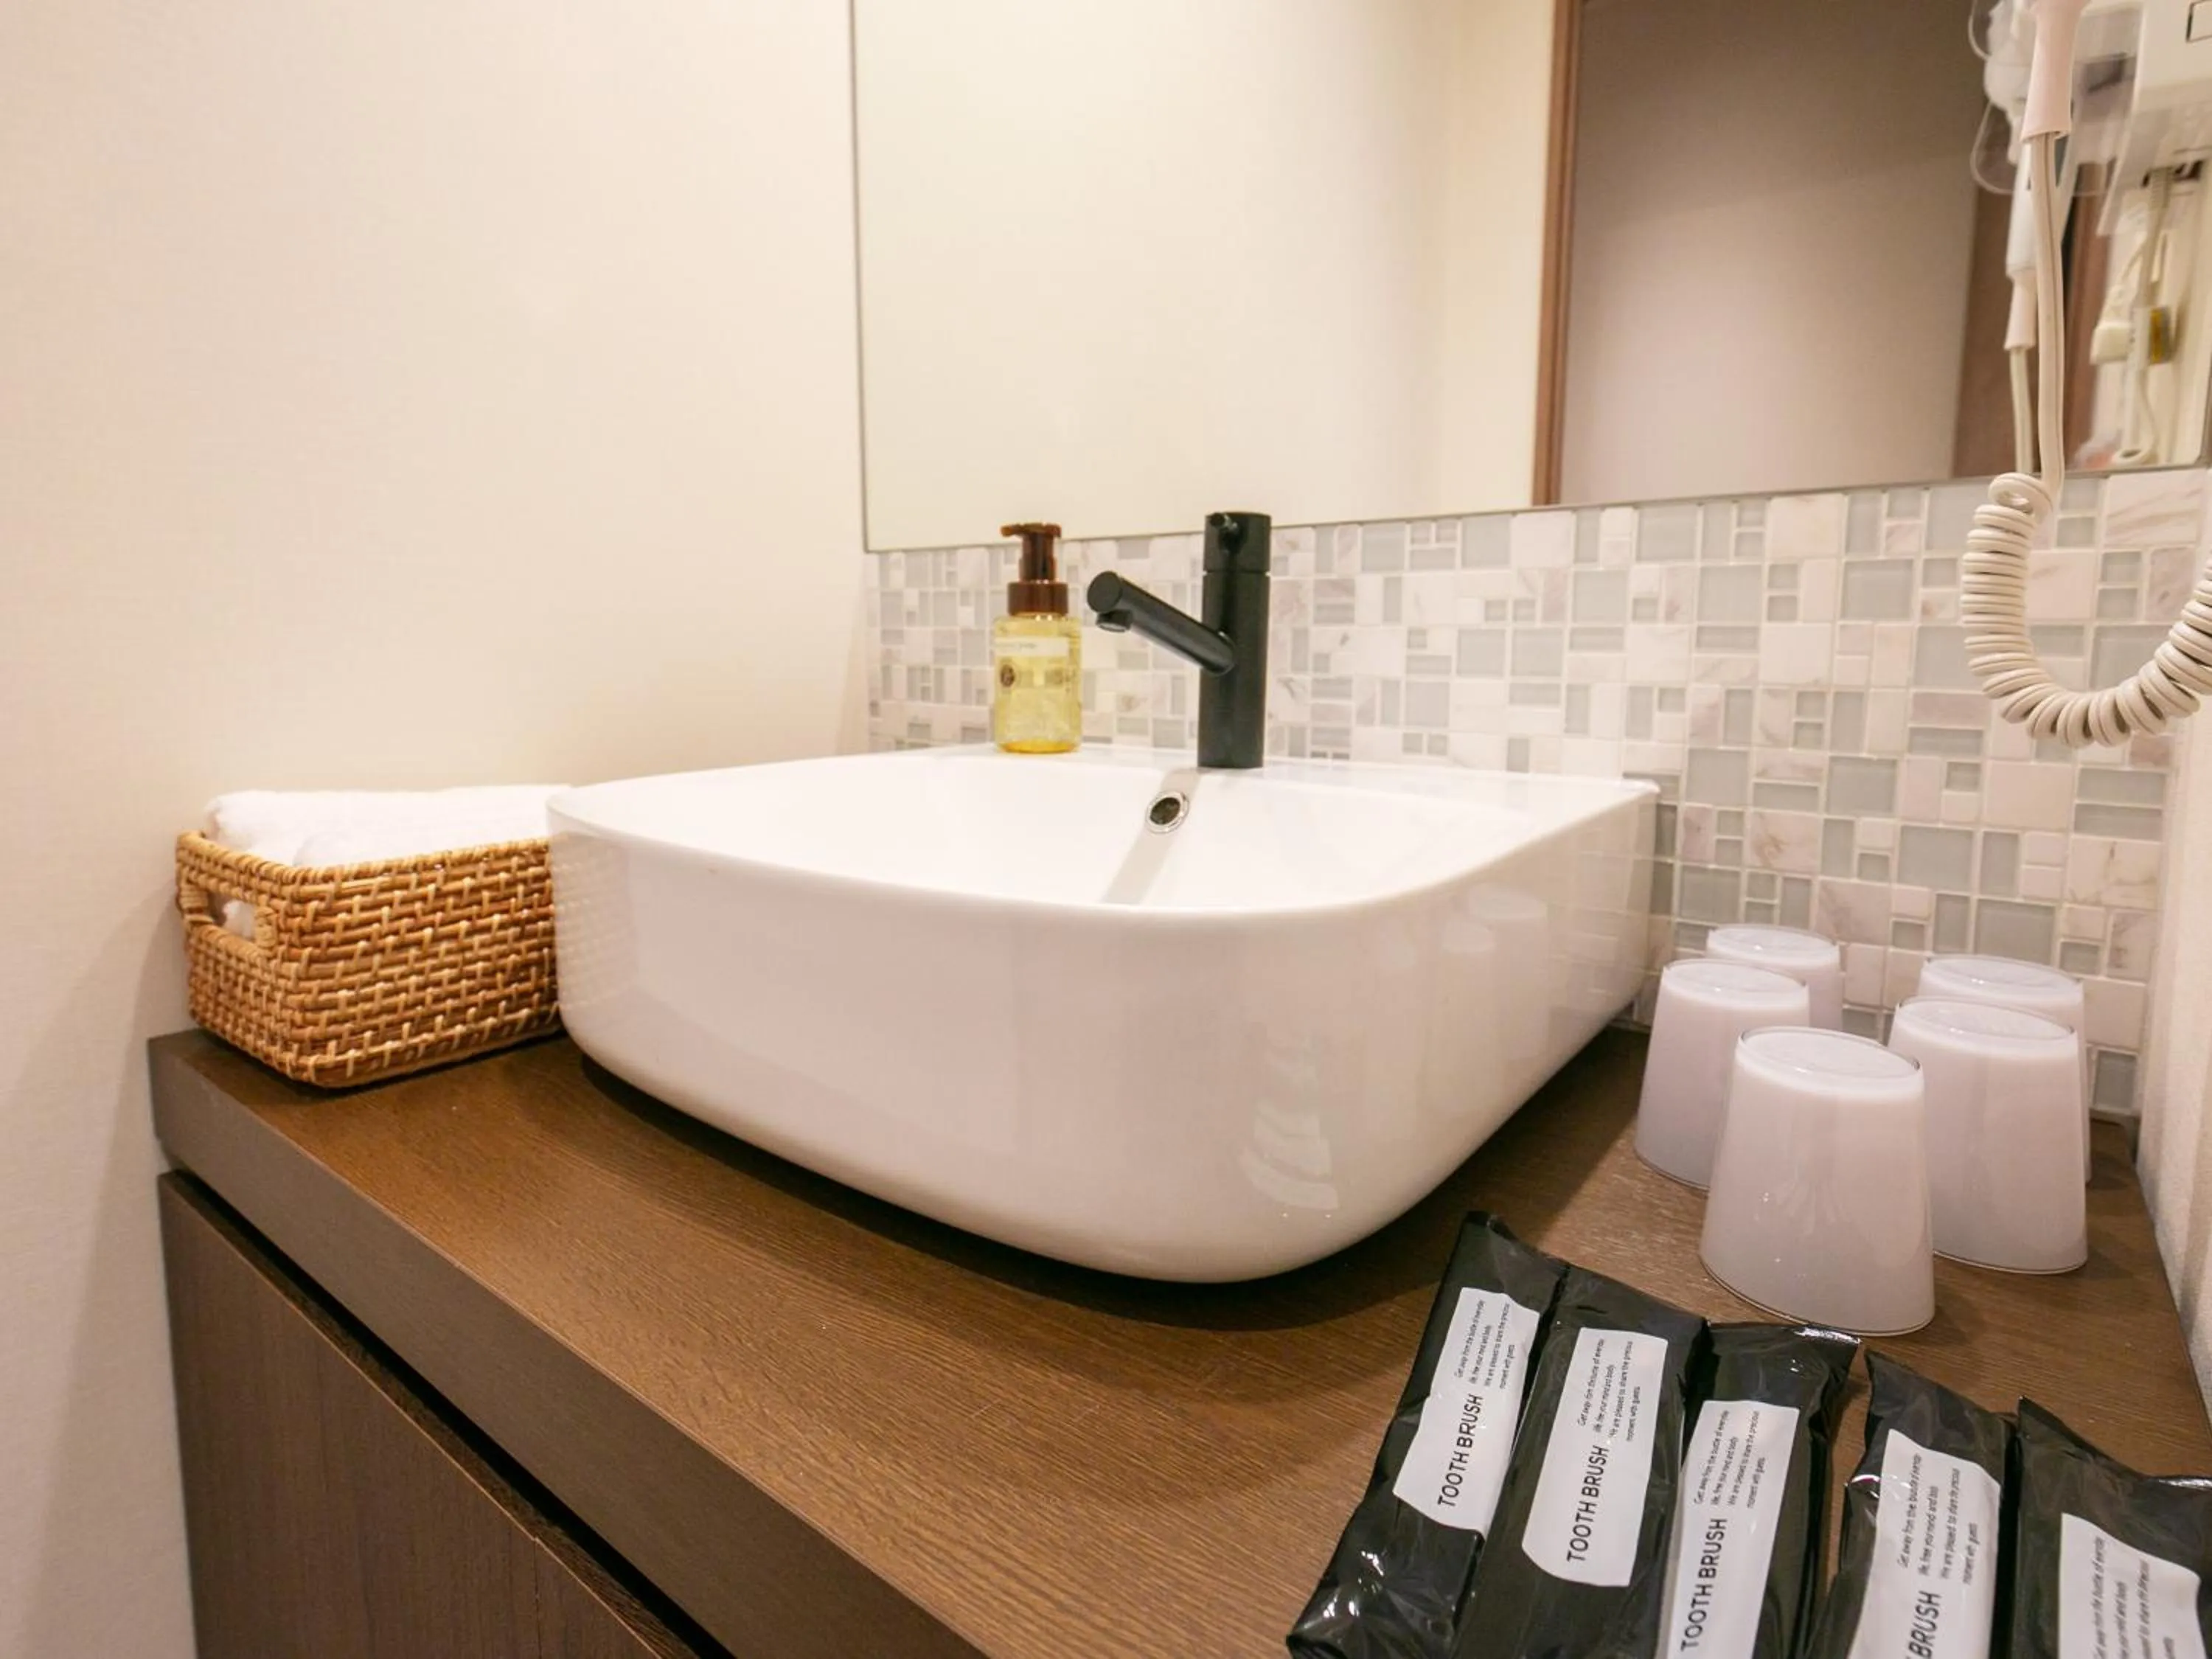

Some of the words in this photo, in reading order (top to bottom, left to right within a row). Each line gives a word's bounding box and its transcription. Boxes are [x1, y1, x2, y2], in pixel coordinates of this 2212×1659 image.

[1437, 1450, 1470, 1506] TOOTH
[1456, 1393, 1484, 1449] BRUSH
[1581, 1444, 1610, 1498] BRUSH
[1566, 1500, 1598, 1562] TOOTH
[1680, 1583, 1714, 1652] TOOTH
[1697, 1518, 1728, 1579] BRUSH
[1908, 1590, 1942, 1659] BRUSH
